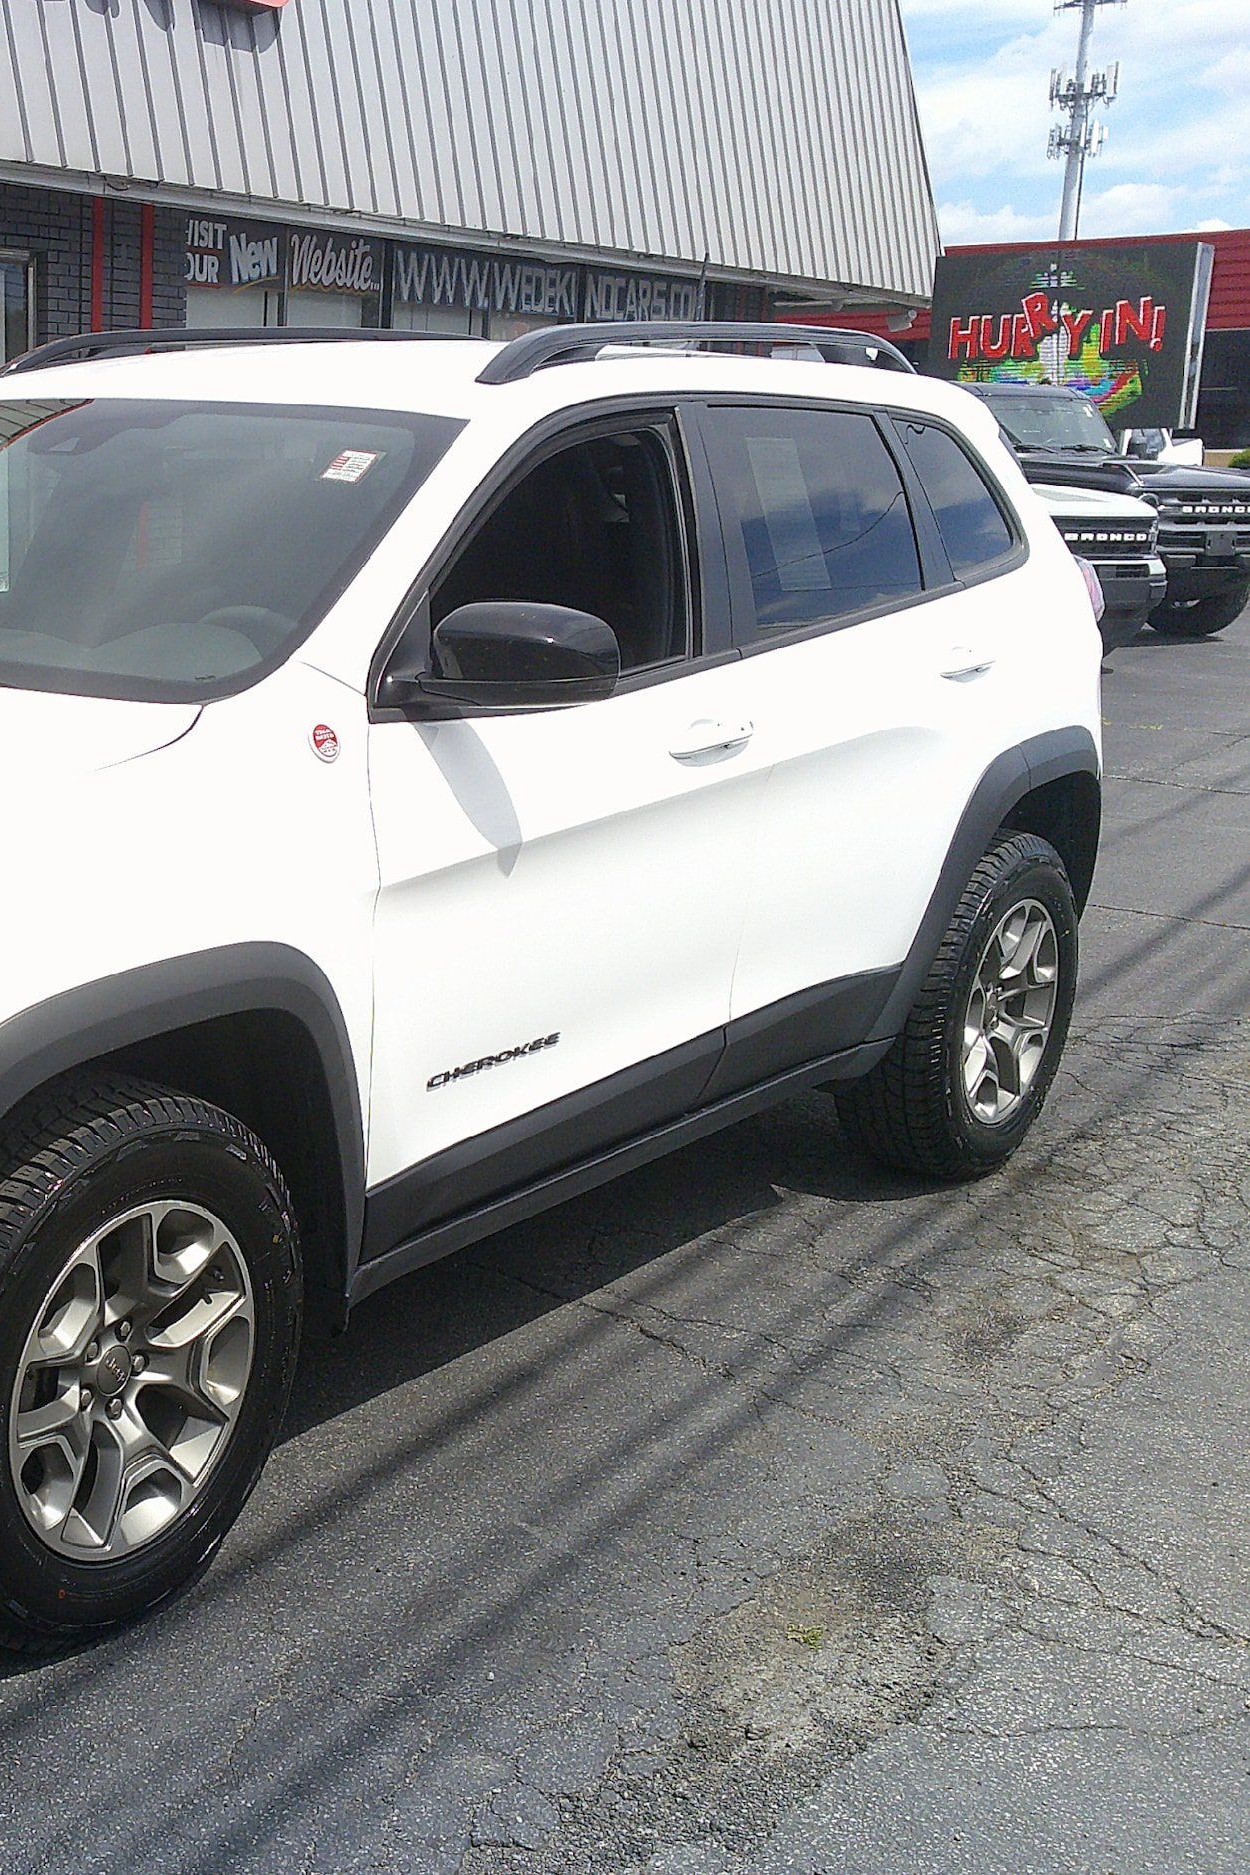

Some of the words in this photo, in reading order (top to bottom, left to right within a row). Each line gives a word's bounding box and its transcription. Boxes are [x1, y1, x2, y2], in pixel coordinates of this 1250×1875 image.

[948, 291, 1093, 358] HURRY
[1099, 296, 1166, 354] IN!
[1182, 505, 1250, 514] BRONC
[1064, 532, 1147, 542] BRONCO
[426, 1031, 561, 1091] CHEROKEE
